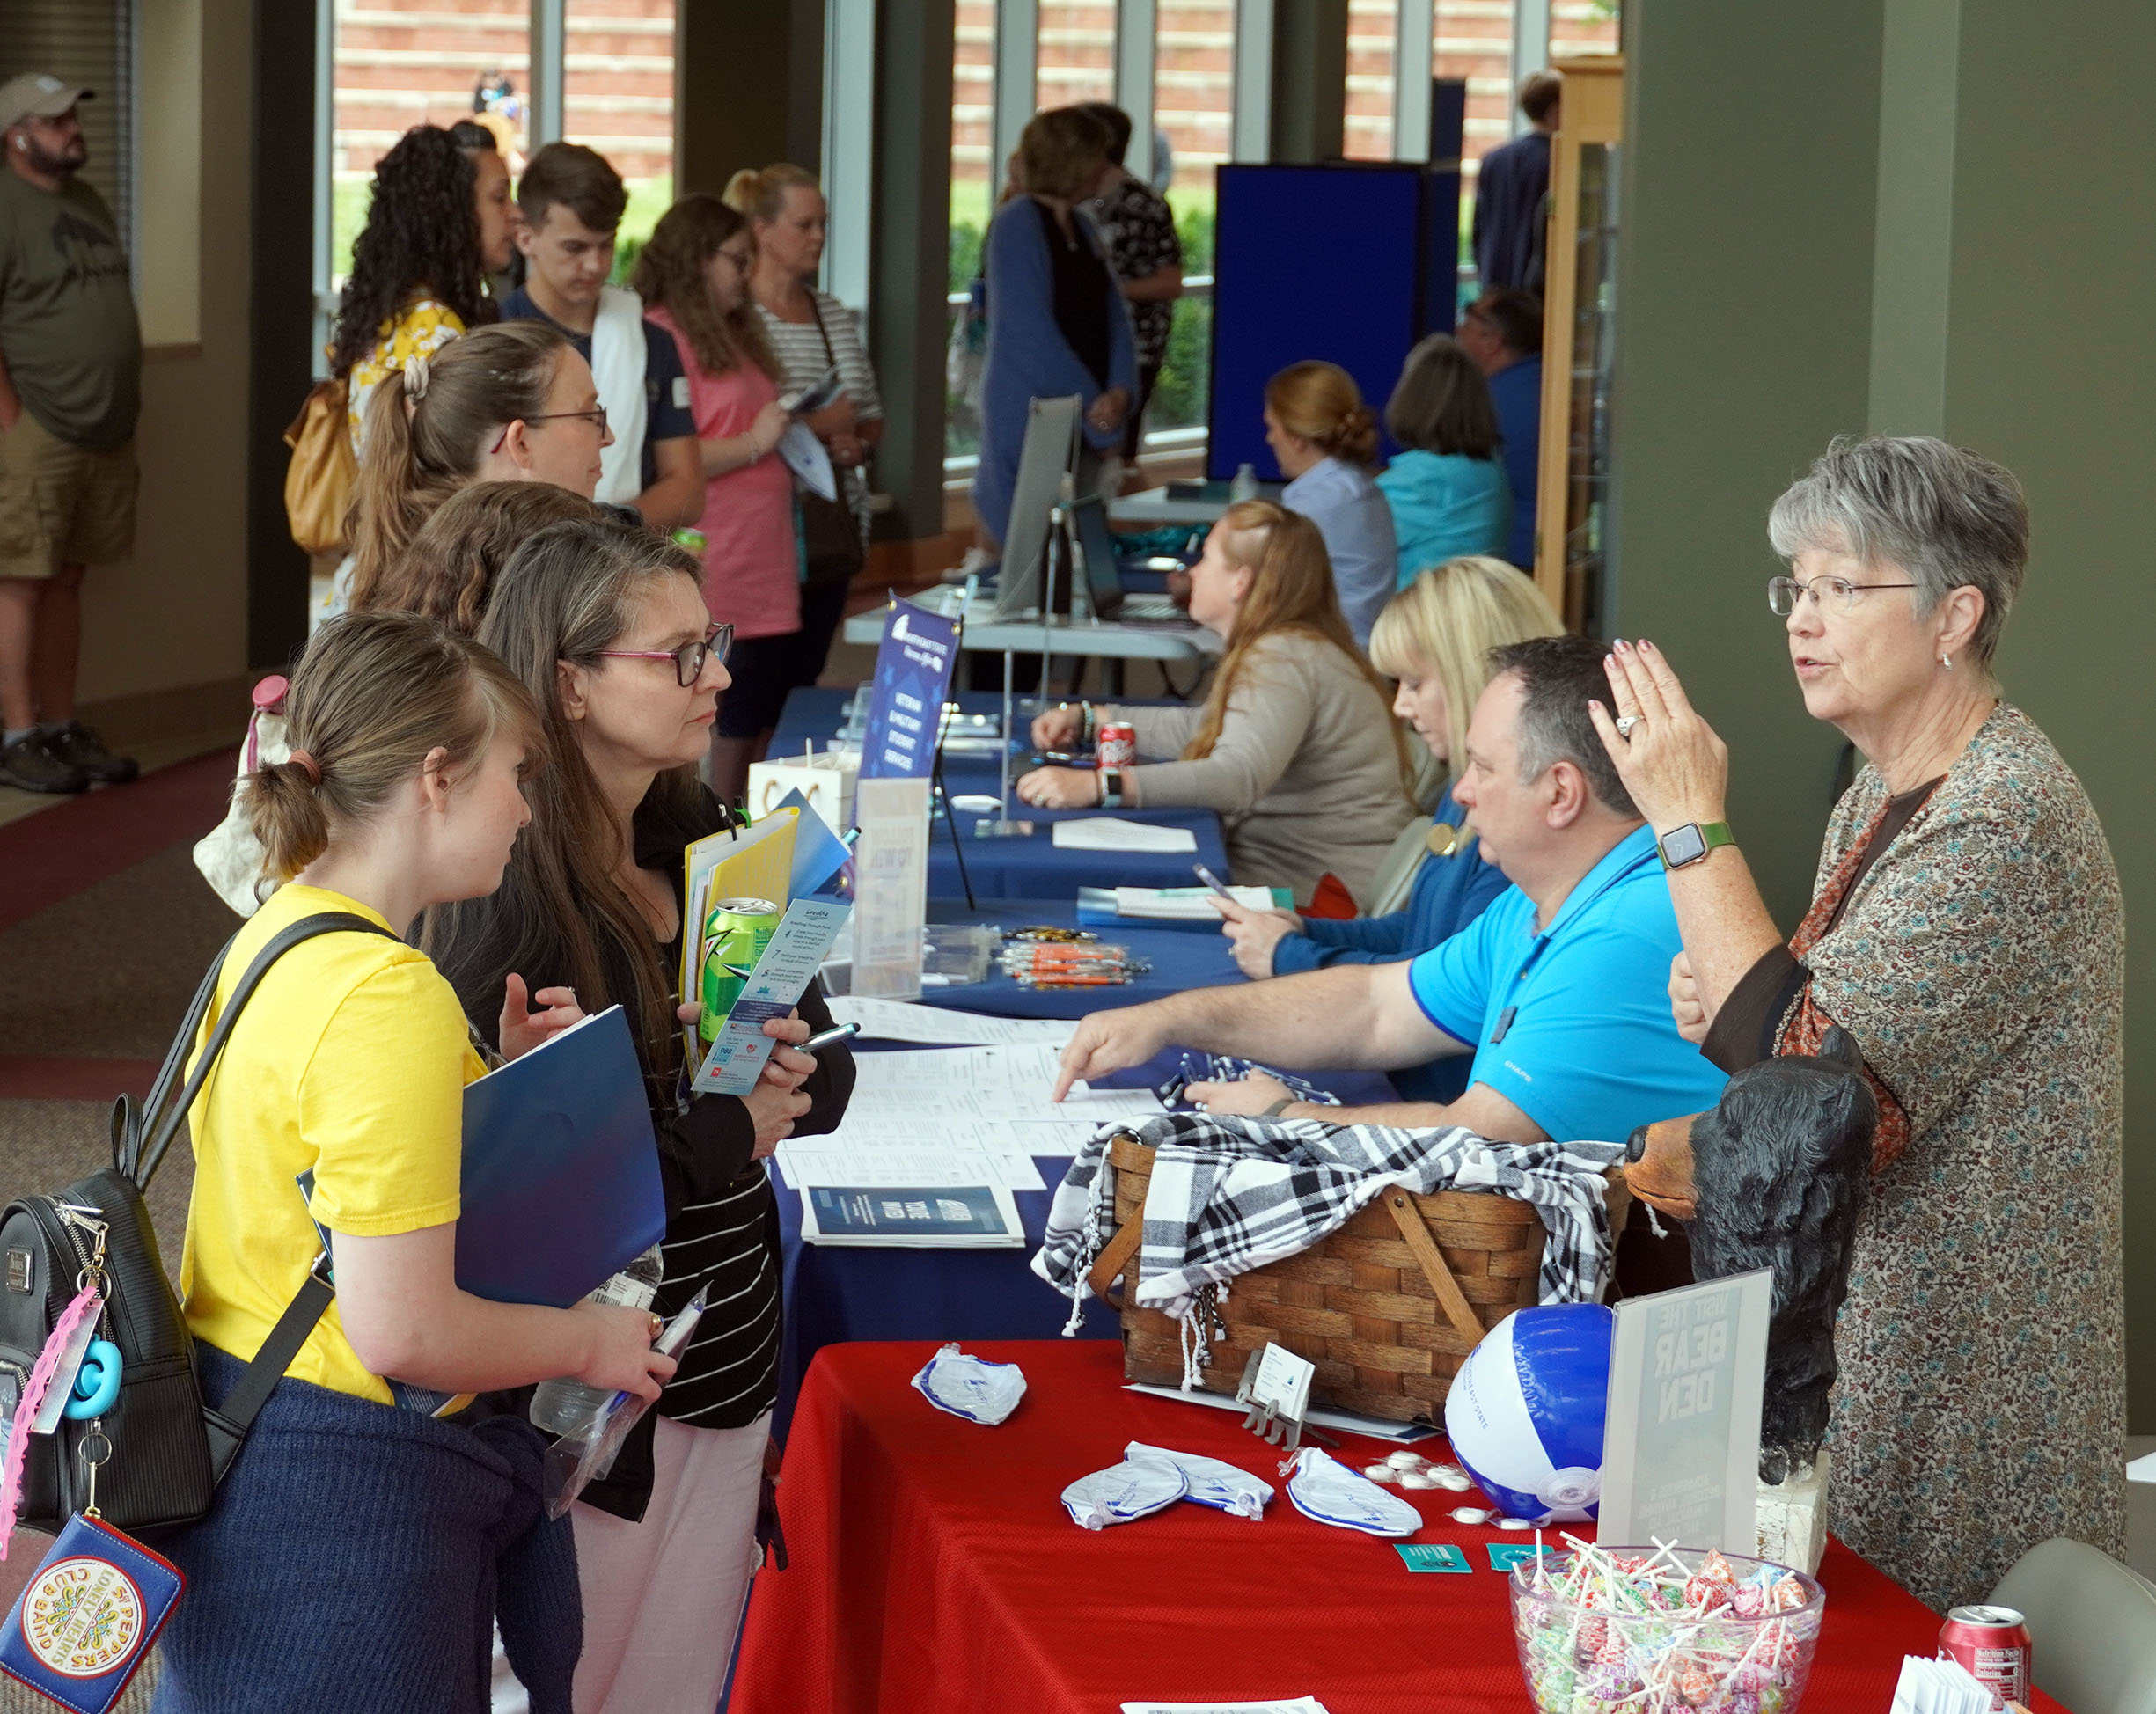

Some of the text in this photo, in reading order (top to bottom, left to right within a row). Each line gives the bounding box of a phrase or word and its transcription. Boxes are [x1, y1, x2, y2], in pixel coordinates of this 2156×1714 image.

[785, 929, 792, 939] 4
[771, 949, 781, 959] 7
[1504, 1060, 1532, 1082] CHAPS
[1474, 1405, 1489, 1430] STATE
[33, 1568, 91, 1650] CLUB BAND
[51, 1569, 115, 1666] LONELY HEARTS
[71, 1608, 134, 1667] PEPPERS
[2013, 1666, 2018, 1676] 0
